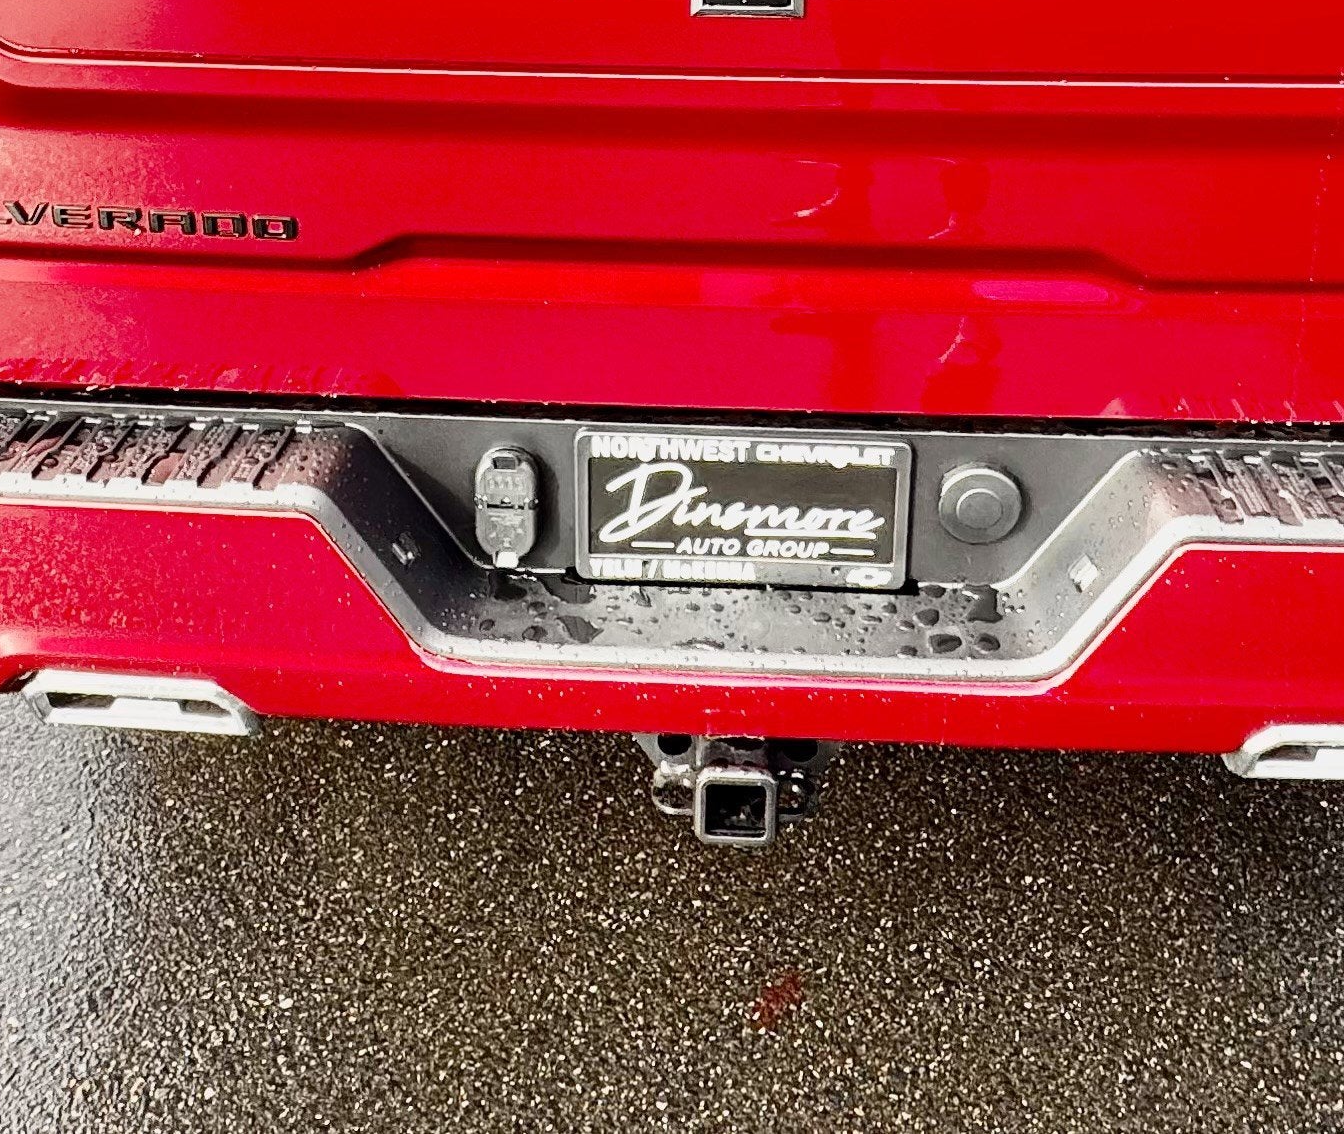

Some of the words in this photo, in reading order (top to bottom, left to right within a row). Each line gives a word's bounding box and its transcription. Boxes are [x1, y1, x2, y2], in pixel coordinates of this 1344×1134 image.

[591, 436, 751, 463] NORTHWEST
[599, 462, 886, 543] Dinsmore
[676, 537, 741, 556] AUTO
[746, 538, 830, 558] GROUP
